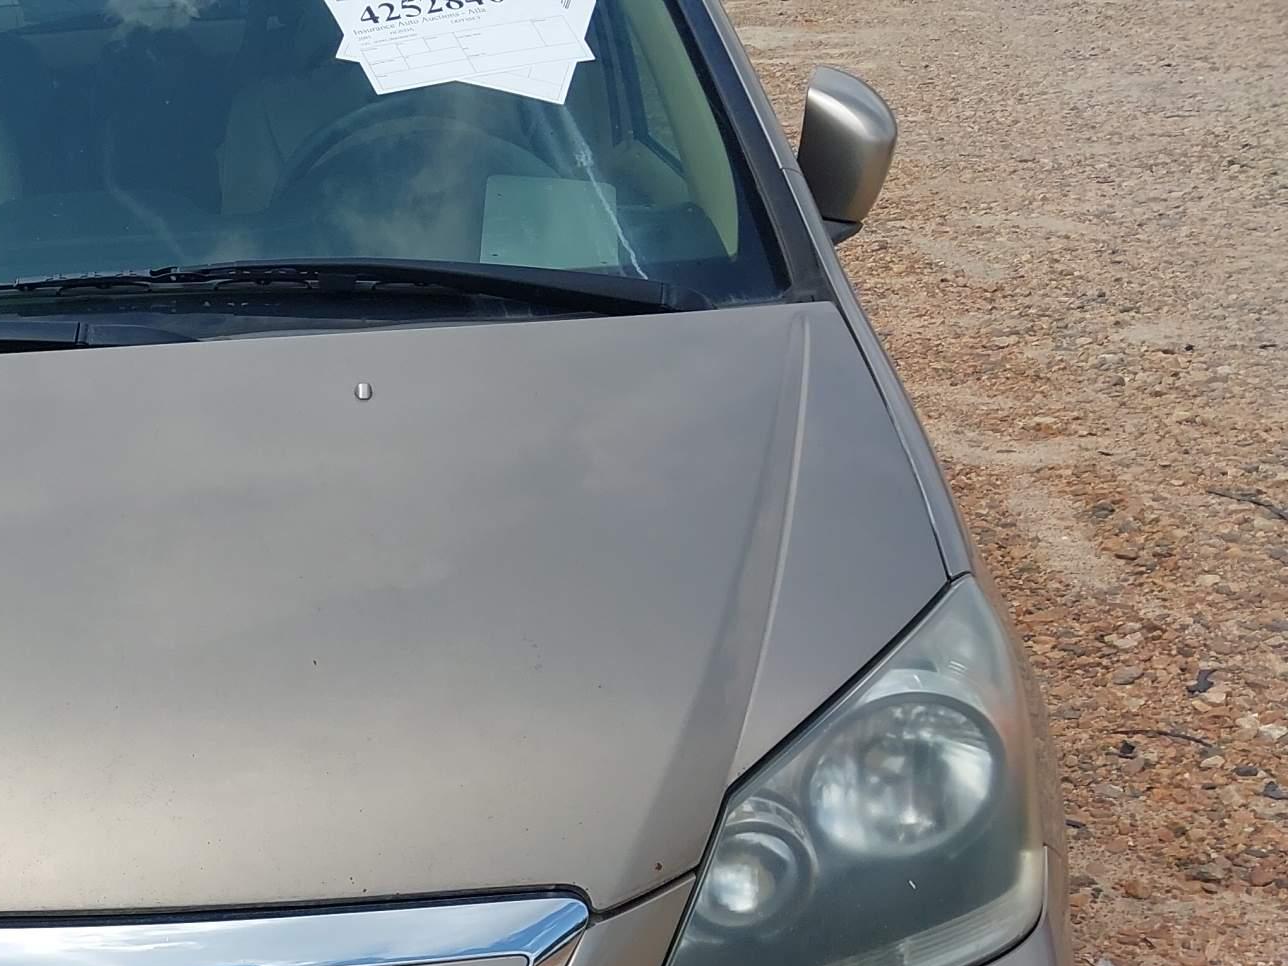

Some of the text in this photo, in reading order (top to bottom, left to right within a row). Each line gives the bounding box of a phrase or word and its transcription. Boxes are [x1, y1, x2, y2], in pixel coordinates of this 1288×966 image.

[352, 23, 396, 36] Insurance
[398, 19, 420, 28] Auto
[422, 12, 460, 25] Auctions
